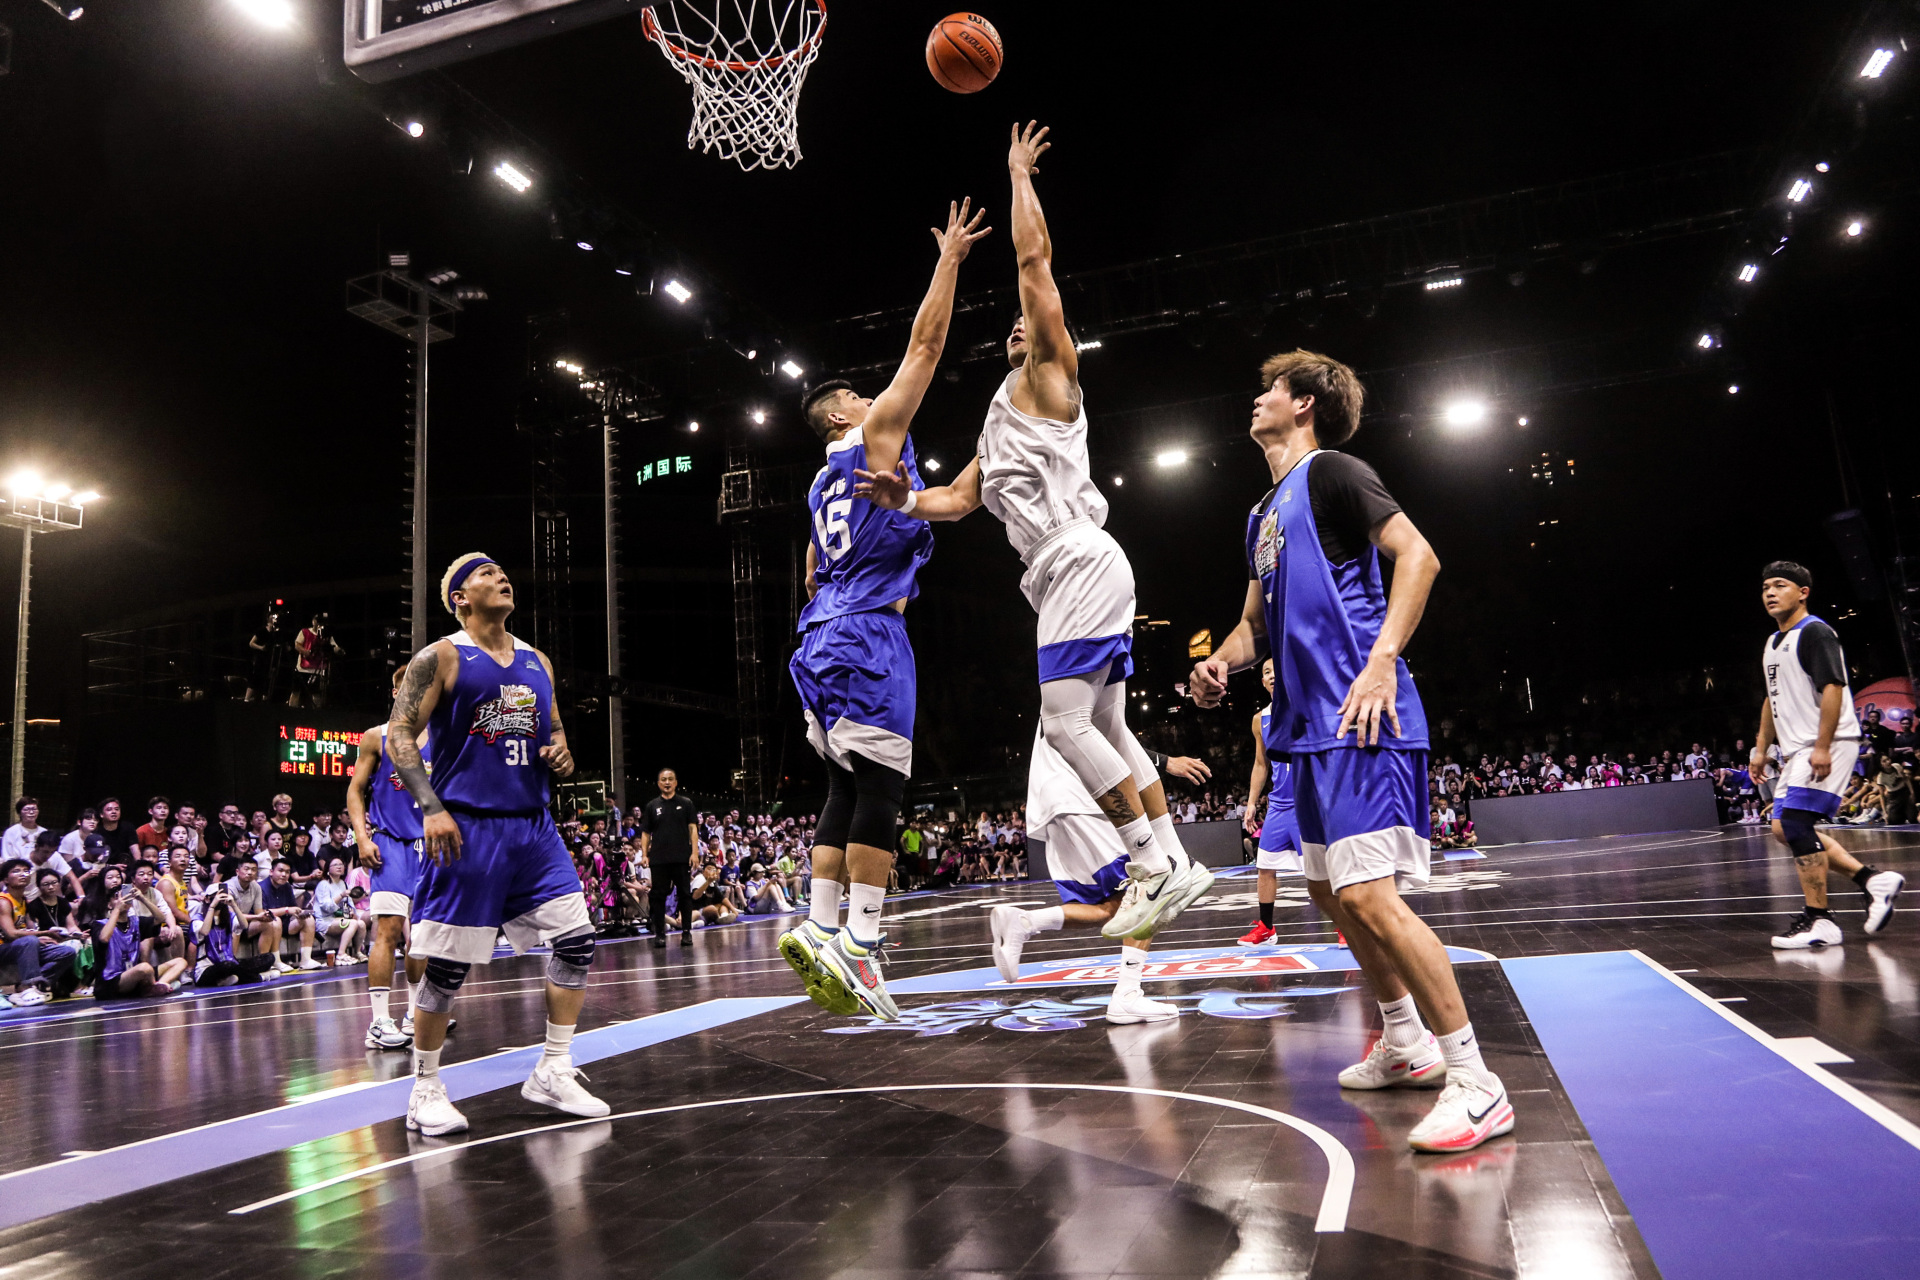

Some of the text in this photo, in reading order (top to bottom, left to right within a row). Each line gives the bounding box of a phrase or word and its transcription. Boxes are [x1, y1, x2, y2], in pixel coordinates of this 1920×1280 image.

[815, 499, 853, 564] 15
[289, 740, 307, 761] 23
[505, 739, 529, 766] 31
[322, 752, 343, 776] 16
